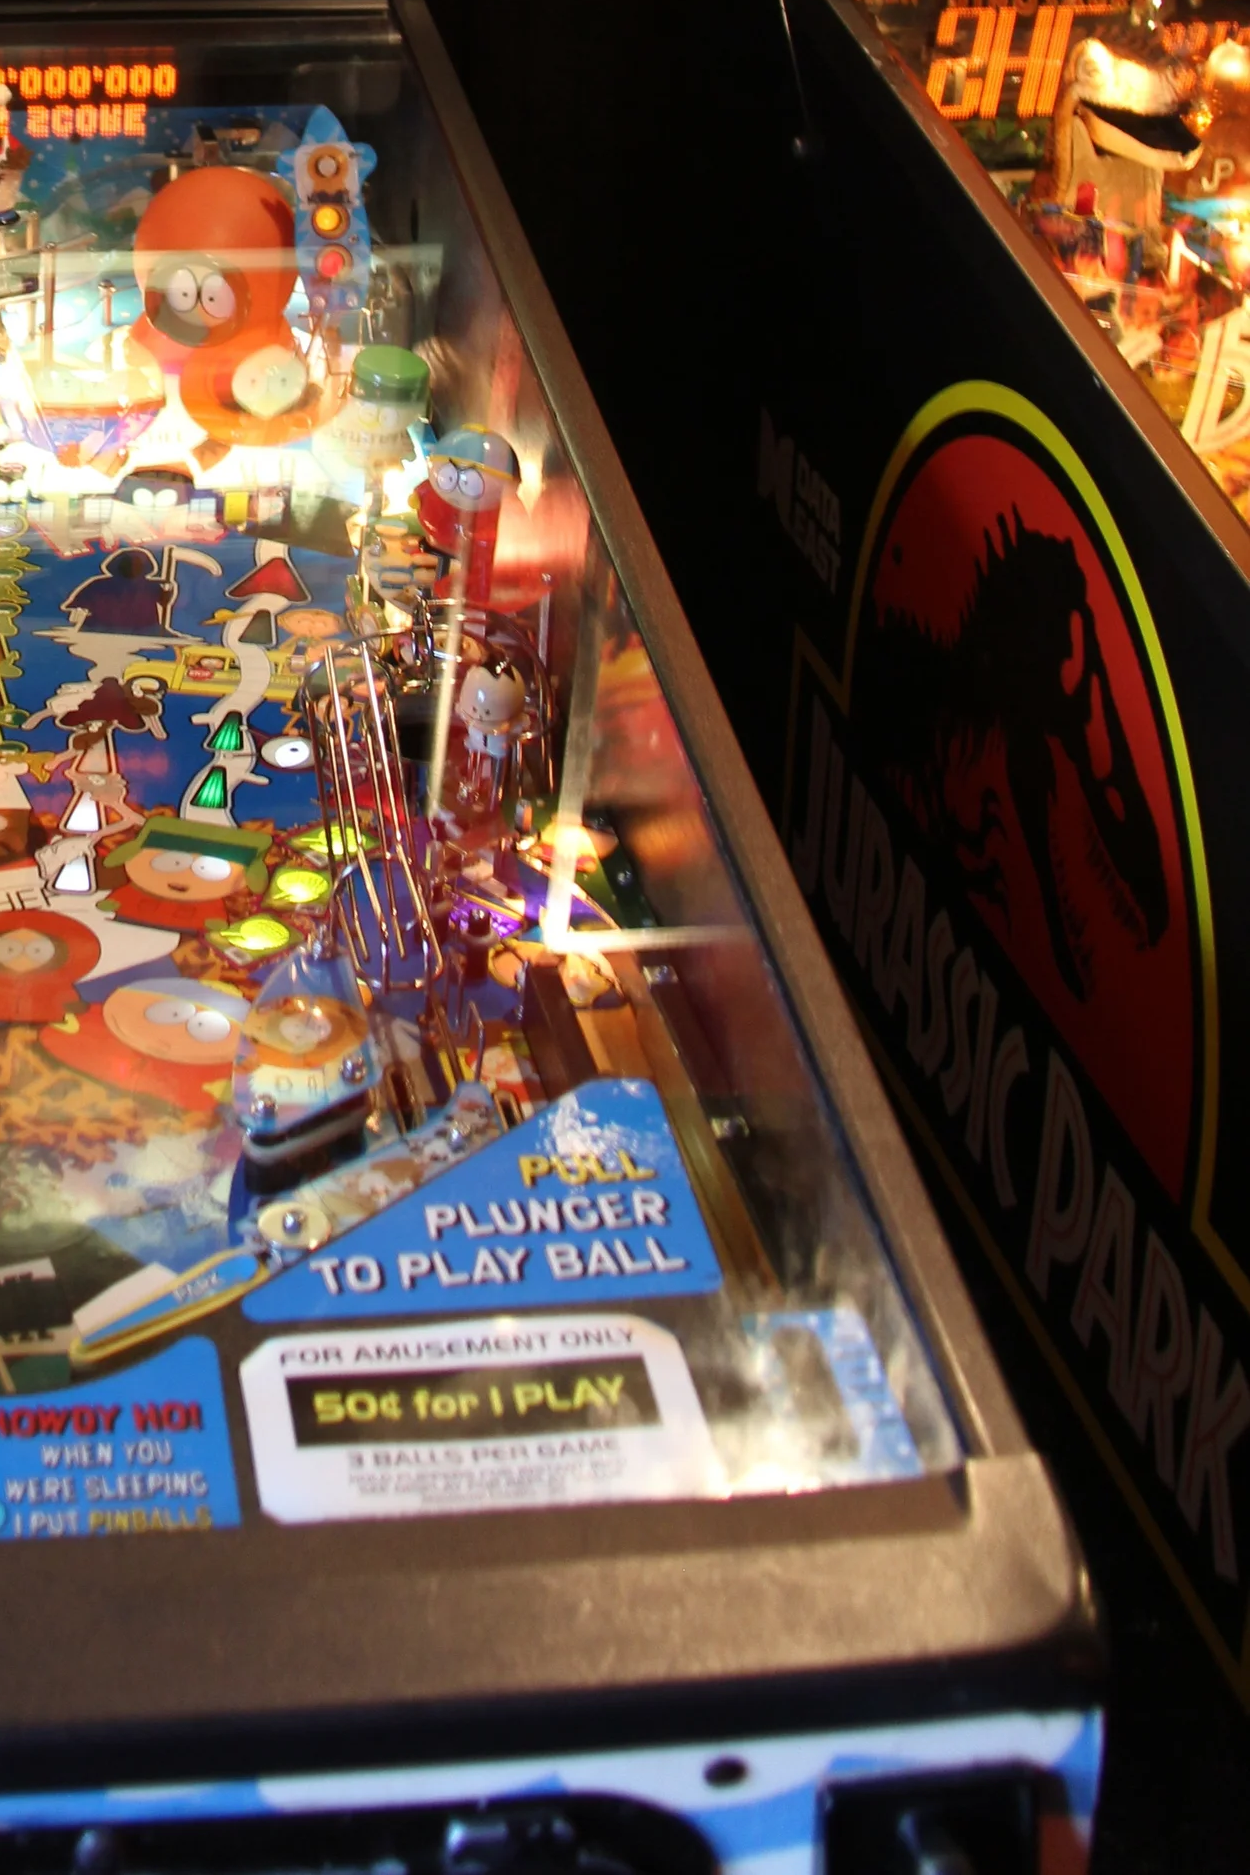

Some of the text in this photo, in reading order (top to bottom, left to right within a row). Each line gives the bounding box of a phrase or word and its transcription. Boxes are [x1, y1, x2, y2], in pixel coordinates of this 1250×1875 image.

[795, 451, 842, 548] DATA
[790, 499, 842, 598] EAST
[791, 694, 1250, 1587] JURASSIC PARK
[518, 1149, 657, 1189] PULL
[424, 1190, 671, 1241] PLUNGER
[309, 1236, 689, 1296] TO PLAY BALL
[279, 1326, 636, 1368] FOR AMUSEMENT ONLY
[132, 1399, 204, 1434] HO!
[312, 1389, 405, 1424] 50¢
[412, 1386, 480, 1421] for
[511, 1373, 627, 1417] PLAY
[40, 1438, 174, 1469] WHEN YOU
[370, 1446, 465, 1468] BALLS
[471, 1442, 533, 1464] PER
[537, 1435, 622, 1460] GAME
[5, 1470, 209, 1504] WERE SLEEPING
[13, 1505, 213, 1538] I PUT PINBALLS
